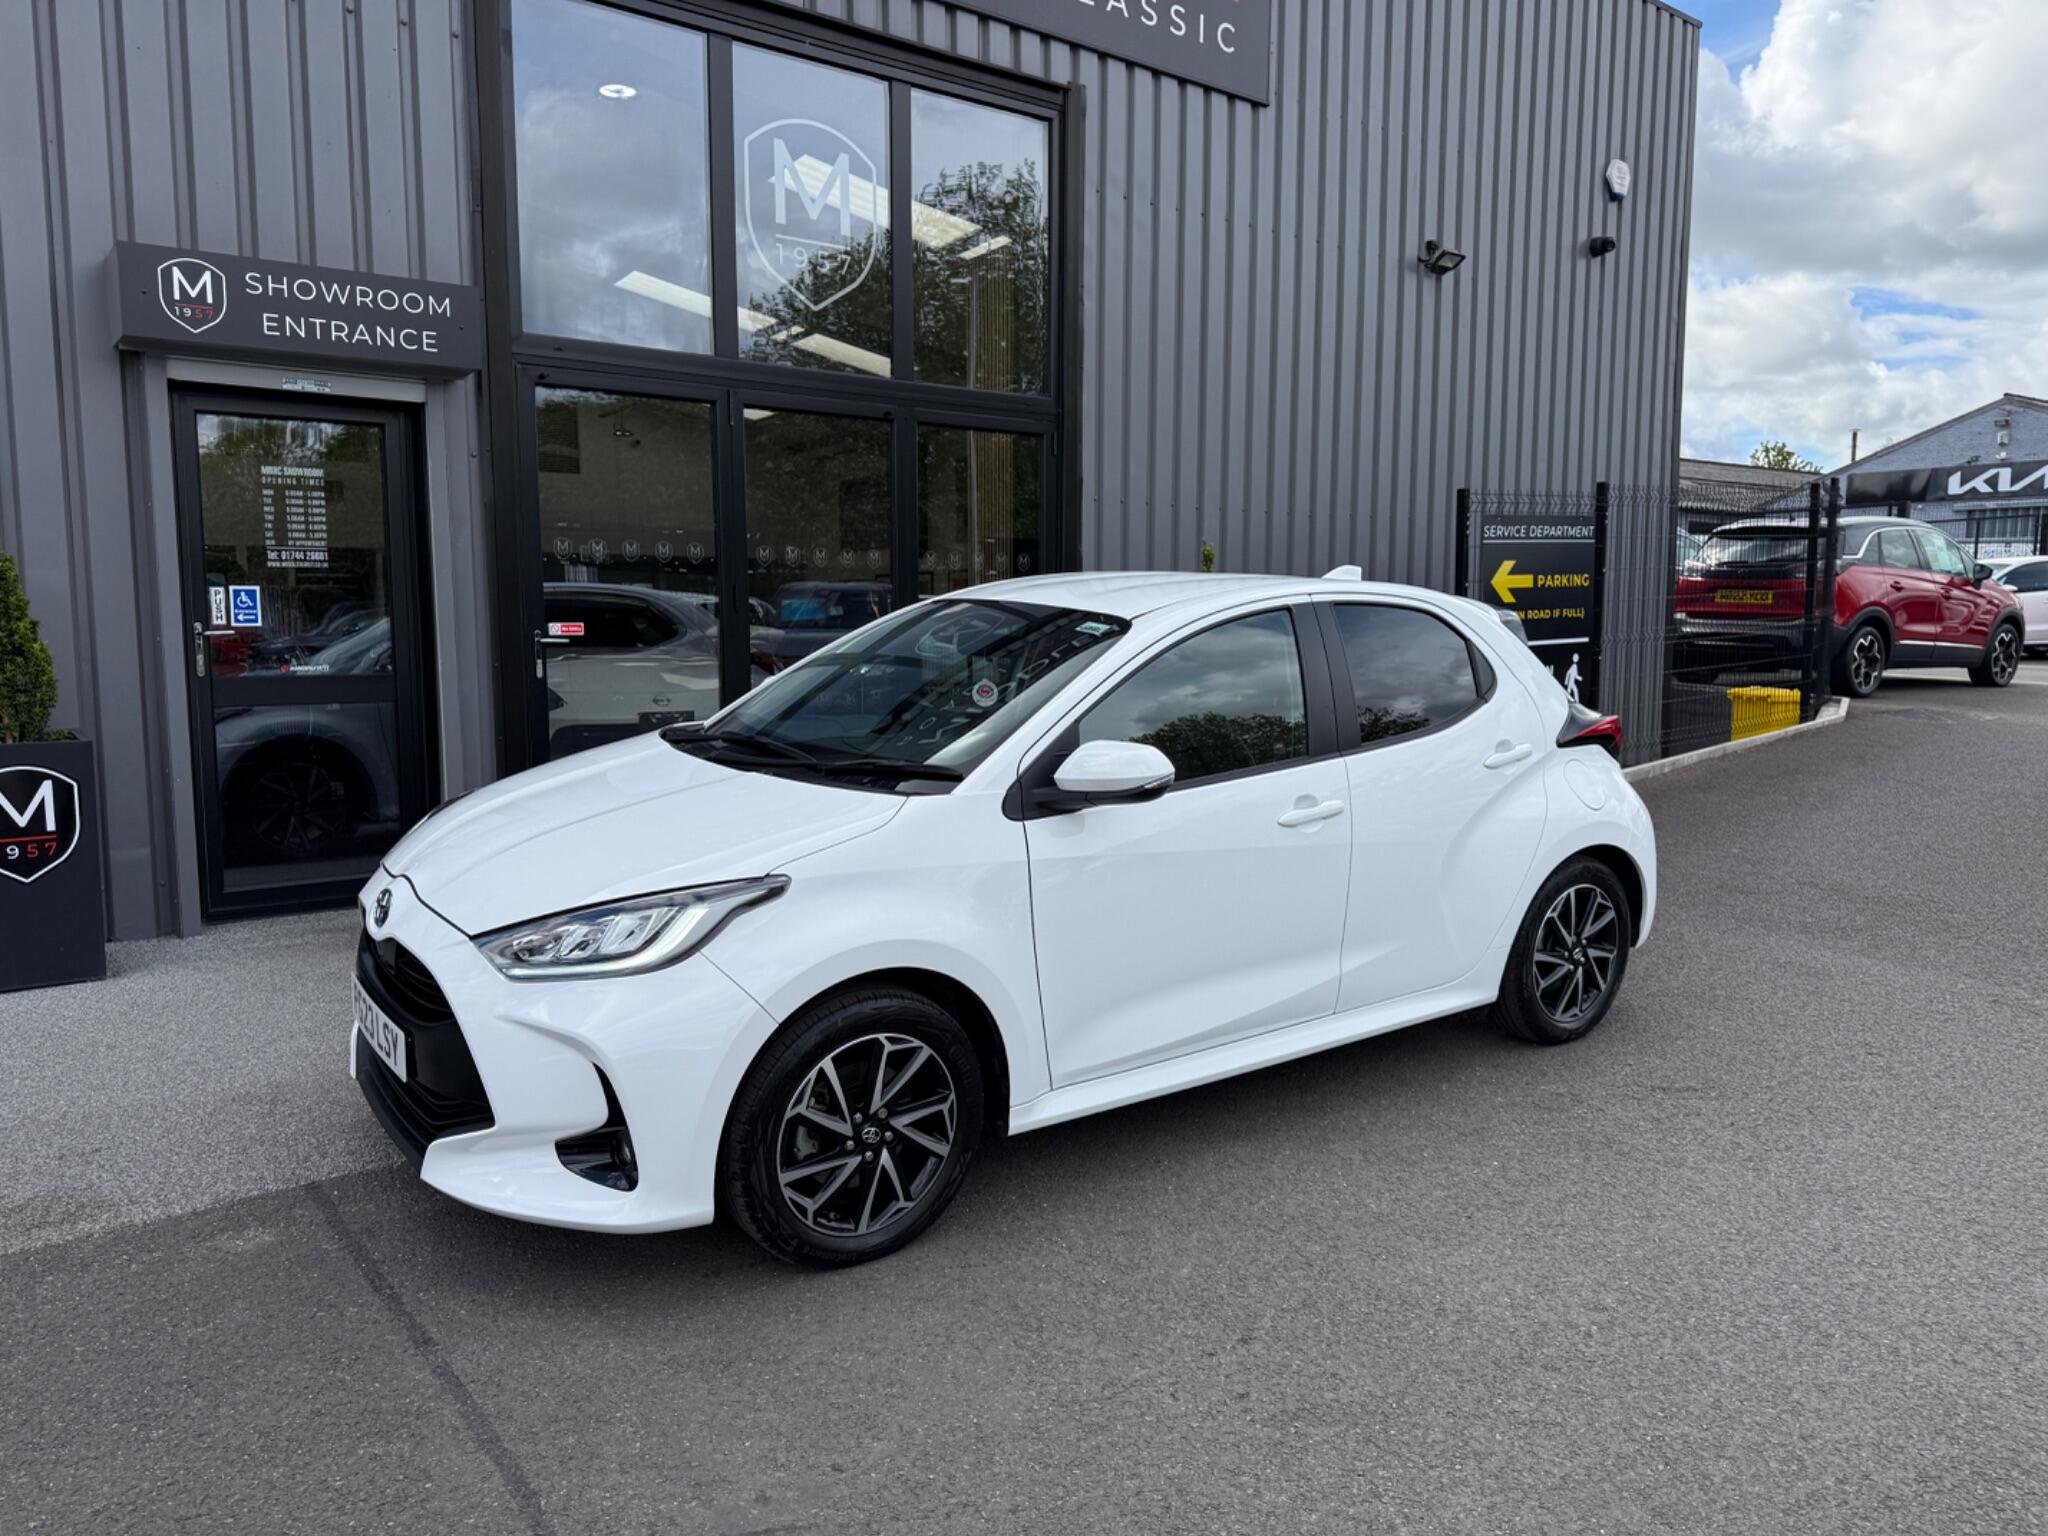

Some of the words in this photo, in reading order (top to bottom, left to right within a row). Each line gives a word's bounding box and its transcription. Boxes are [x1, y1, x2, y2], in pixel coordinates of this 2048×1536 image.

[1079, 0, 1236, 53] ASSIC
[774, 137, 850, 236] M
[775, 243, 851, 275] 1957
[172, 266, 213, 304] M
[245, 272, 451, 318] SHOWROOM
[175, 306, 213, 320] 1957
[263, 313, 438, 352] ENTRANCE
[262, 476, 297, 485] OPENING
[301, 478, 324, 487] TIMES
[1483, 525, 1526, 538] SERVICE
[1529, 525, 1595, 538] DEPARTMENT
[281, 550, 305, 560] 01744
[1537, 574, 1590, 588] PARKING
[214, 589, 223, 622] PUSH
[1527, 610, 1551, 619] ROAD
[1553, 609, 1560, 619] IF
[1562, 608, 1585, 619] FULL)
[376, 1012, 398, 1066] LSY
